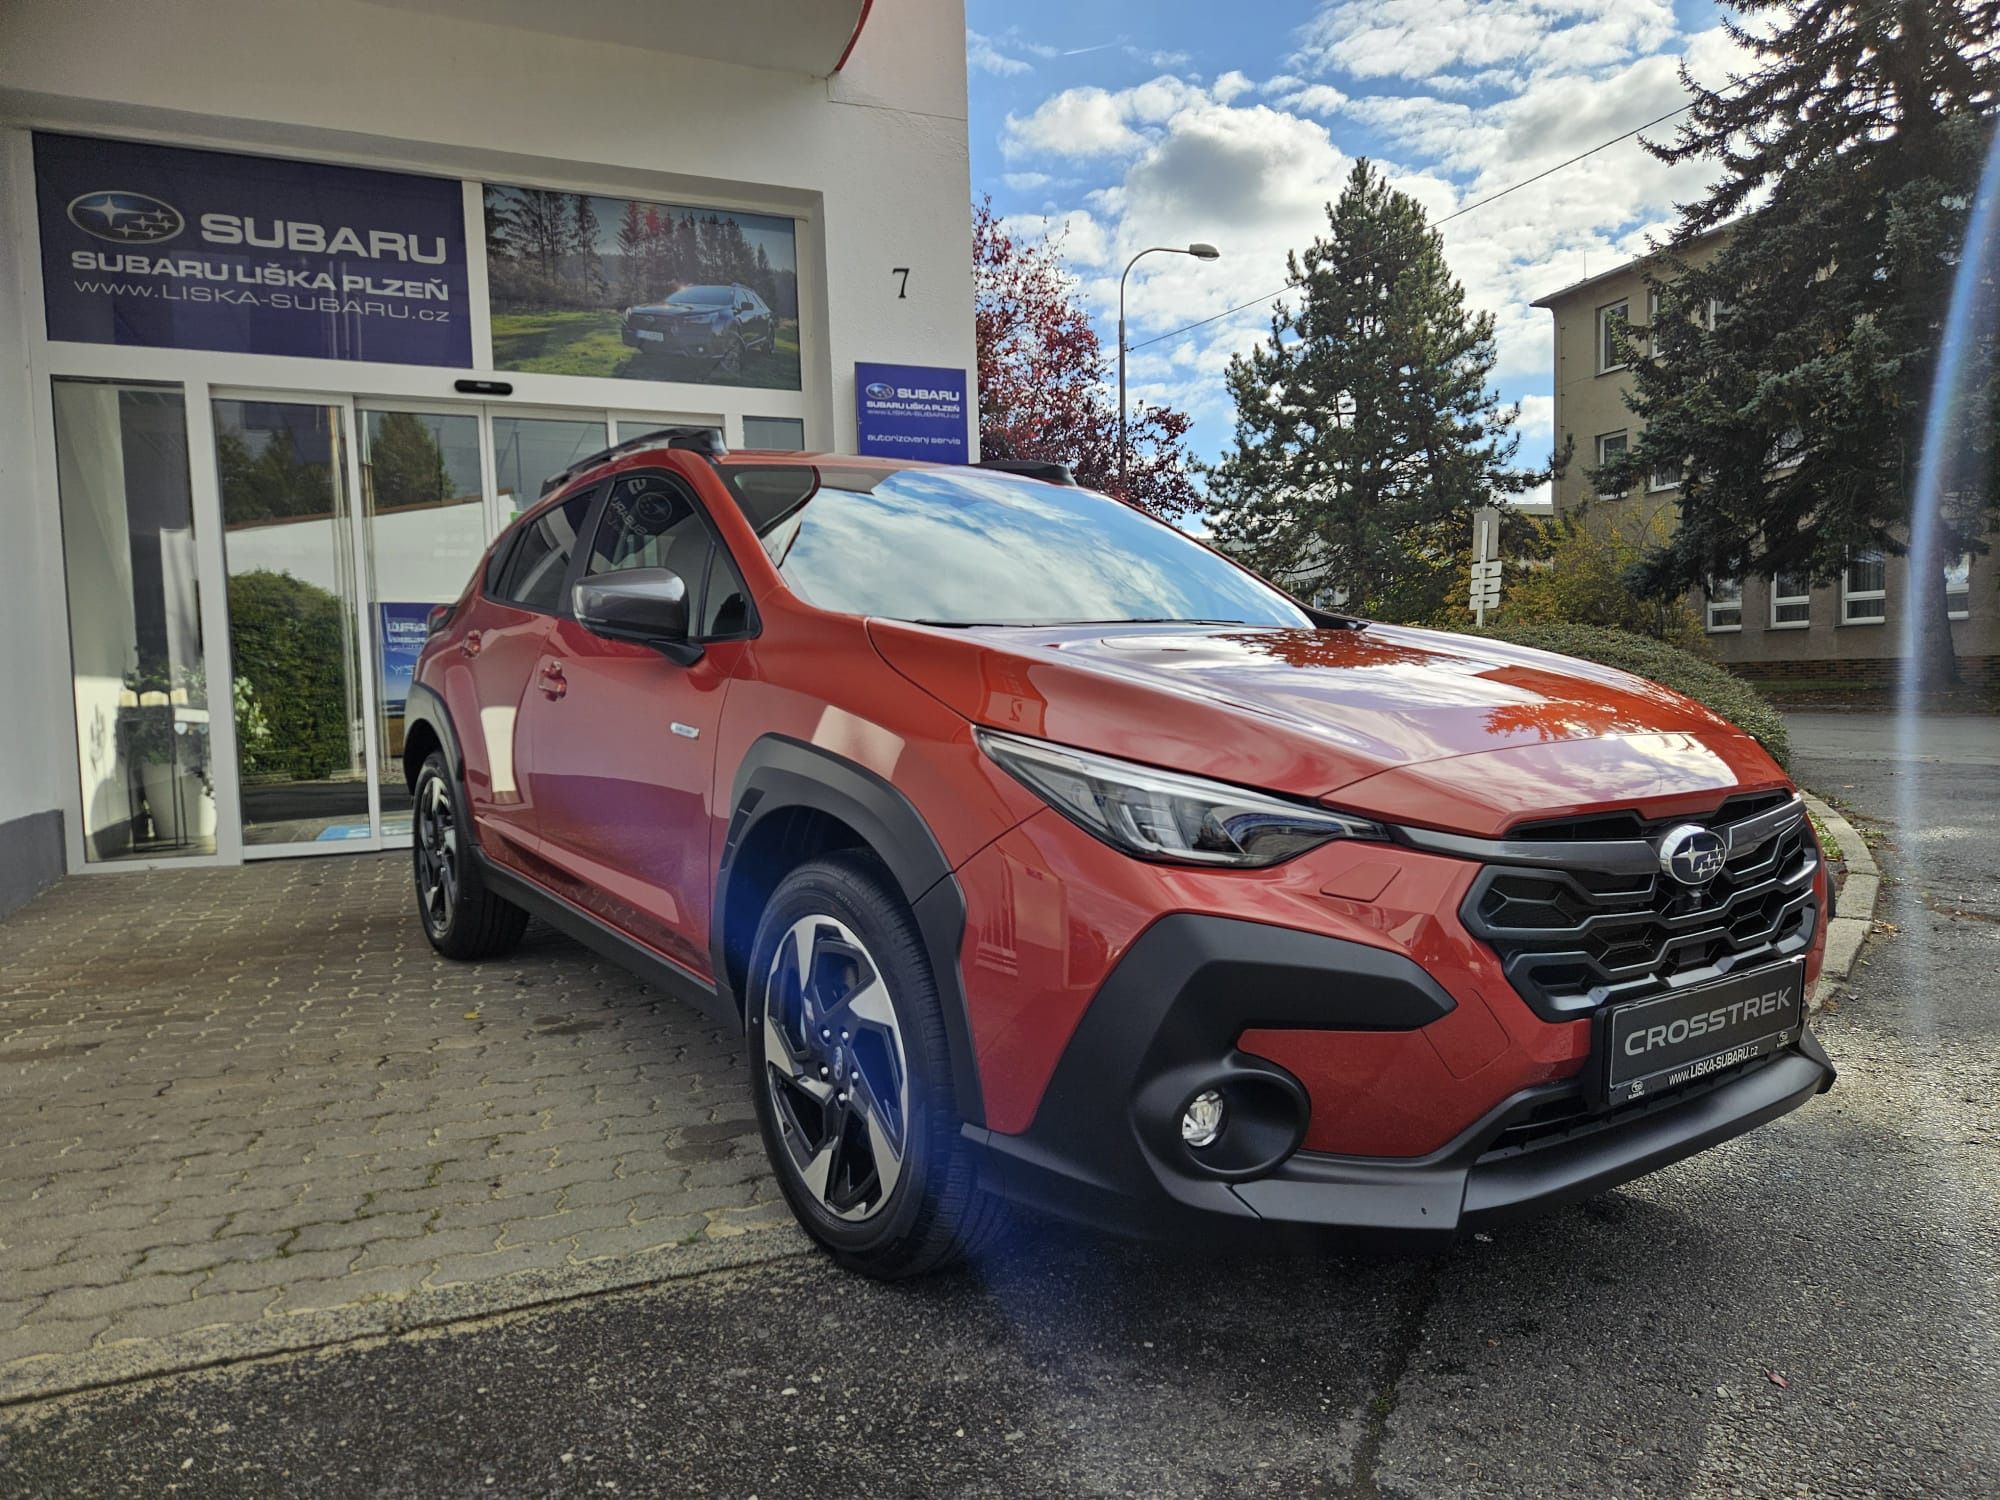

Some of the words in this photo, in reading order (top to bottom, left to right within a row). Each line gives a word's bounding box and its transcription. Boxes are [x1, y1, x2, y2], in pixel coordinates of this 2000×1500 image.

[200, 213, 447, 265] SUBARU
[71, 250, 230, 281] SUBARU
[235, 261, 337, 291] LIŠKA
[342, 276, 449, 301] PLZEŇ
[892, 267, 910, 299] 7
[866, 400, 905, 410] SUBARU
[897, 388, 960, 401] SUBARU
[930, 436, 961, 445] servis
[1624, 986, 1792, 1056] CROSSTREK
